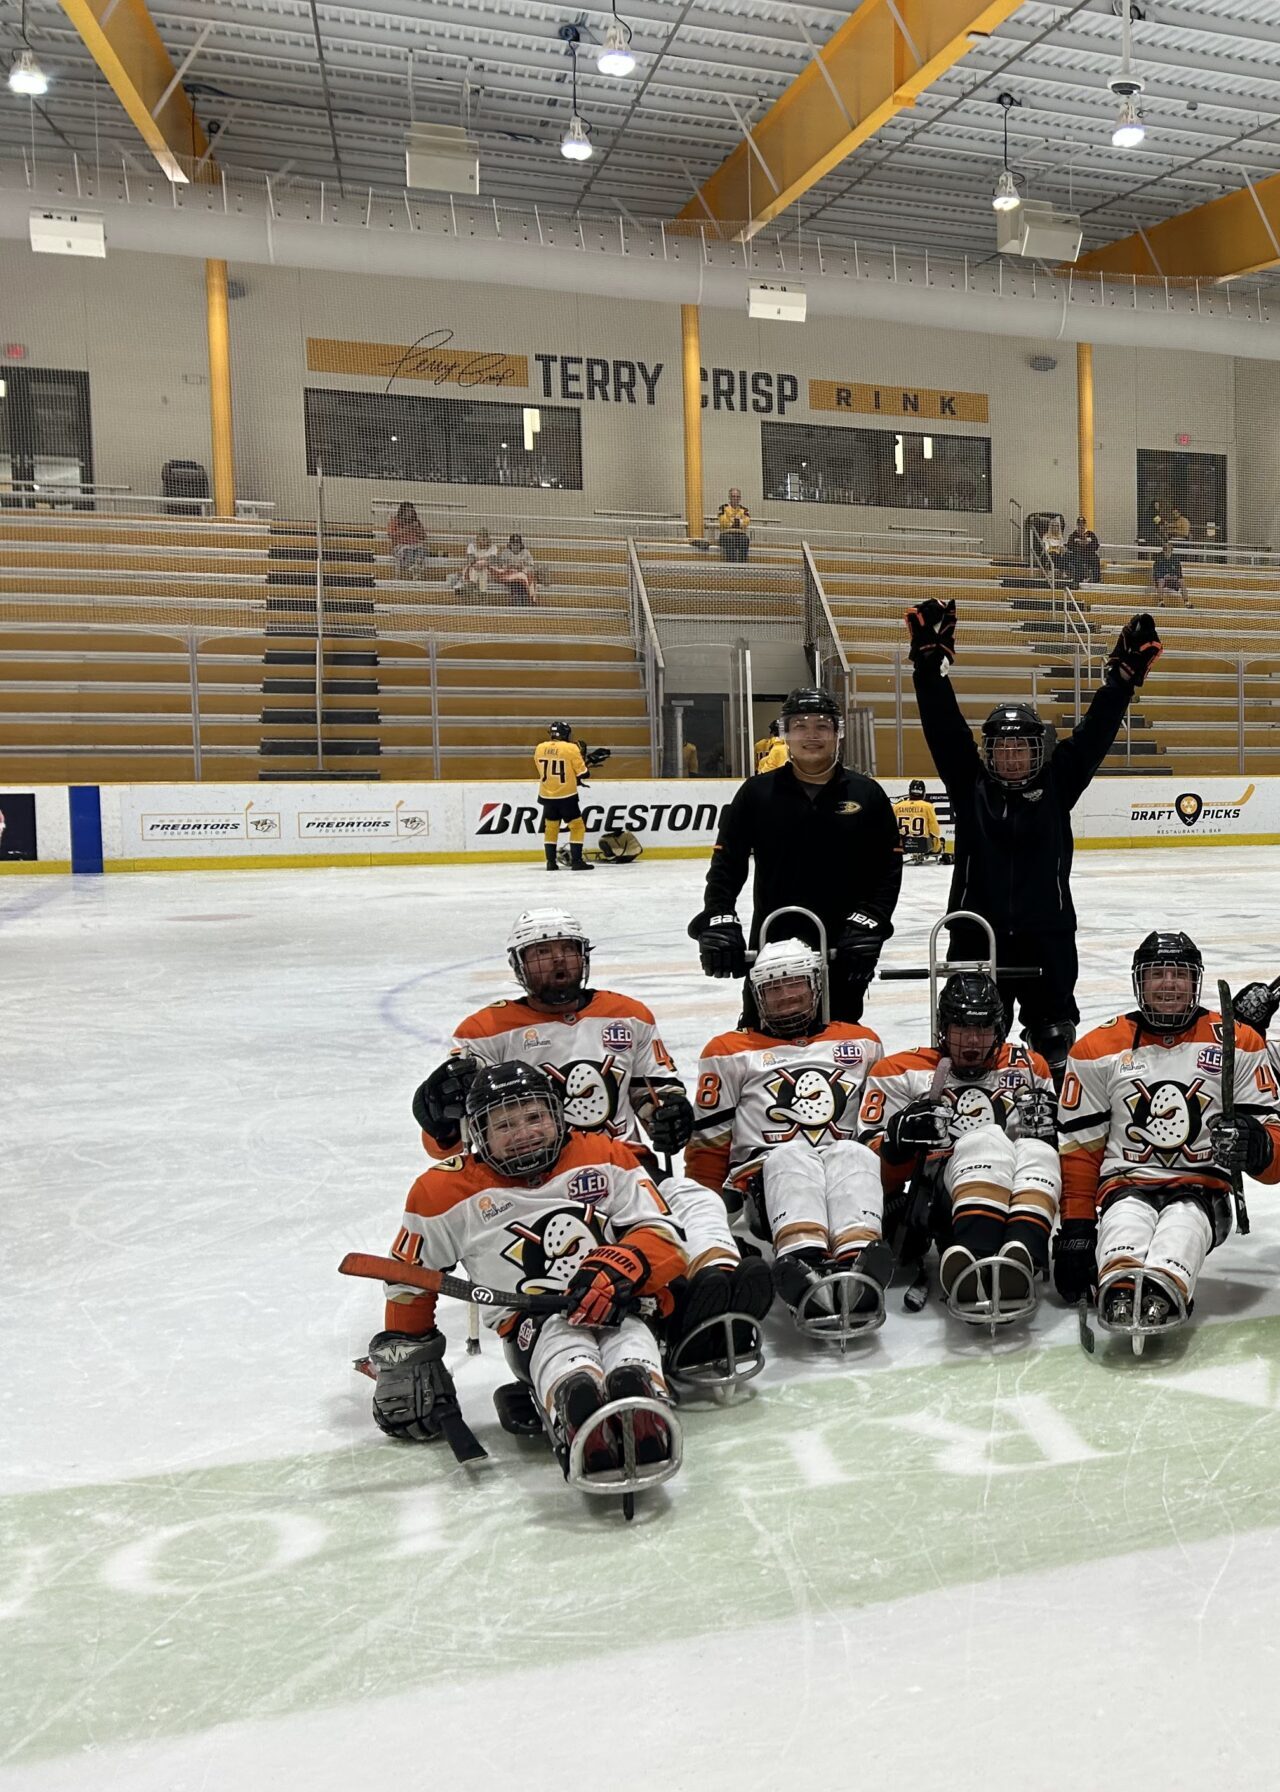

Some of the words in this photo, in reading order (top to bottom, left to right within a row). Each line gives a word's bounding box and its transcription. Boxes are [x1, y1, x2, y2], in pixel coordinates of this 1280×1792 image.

[534, 354, 665, 405] TERRY
[836, 388, 956, 415] RINK
[538, 759, 565, 783] 74
[475, 803, 731, 834] BRGESTON
[1131, 810, 1174, 821] DRAFT
[1202, 809, 1240, 819] PICKS
[898, 816, 925, 837] 59
[603, 1029, 632, 1041] SLED
[834, 1046, 862, 1057] SLED
[1008, 1045, 1034, 1066] A
[1198, 1050, 1223, 1066] SLE
[697, 1073, 722, 1109] 8
[1061, 1072, 1083, 1109] 0
[1255, 1065, 1278, 1100] 4
[861, 1088, 886, 1124] 8
[960, 1163, 992, 1173] TRON
[569, 1175, 609, 1195] SLED
